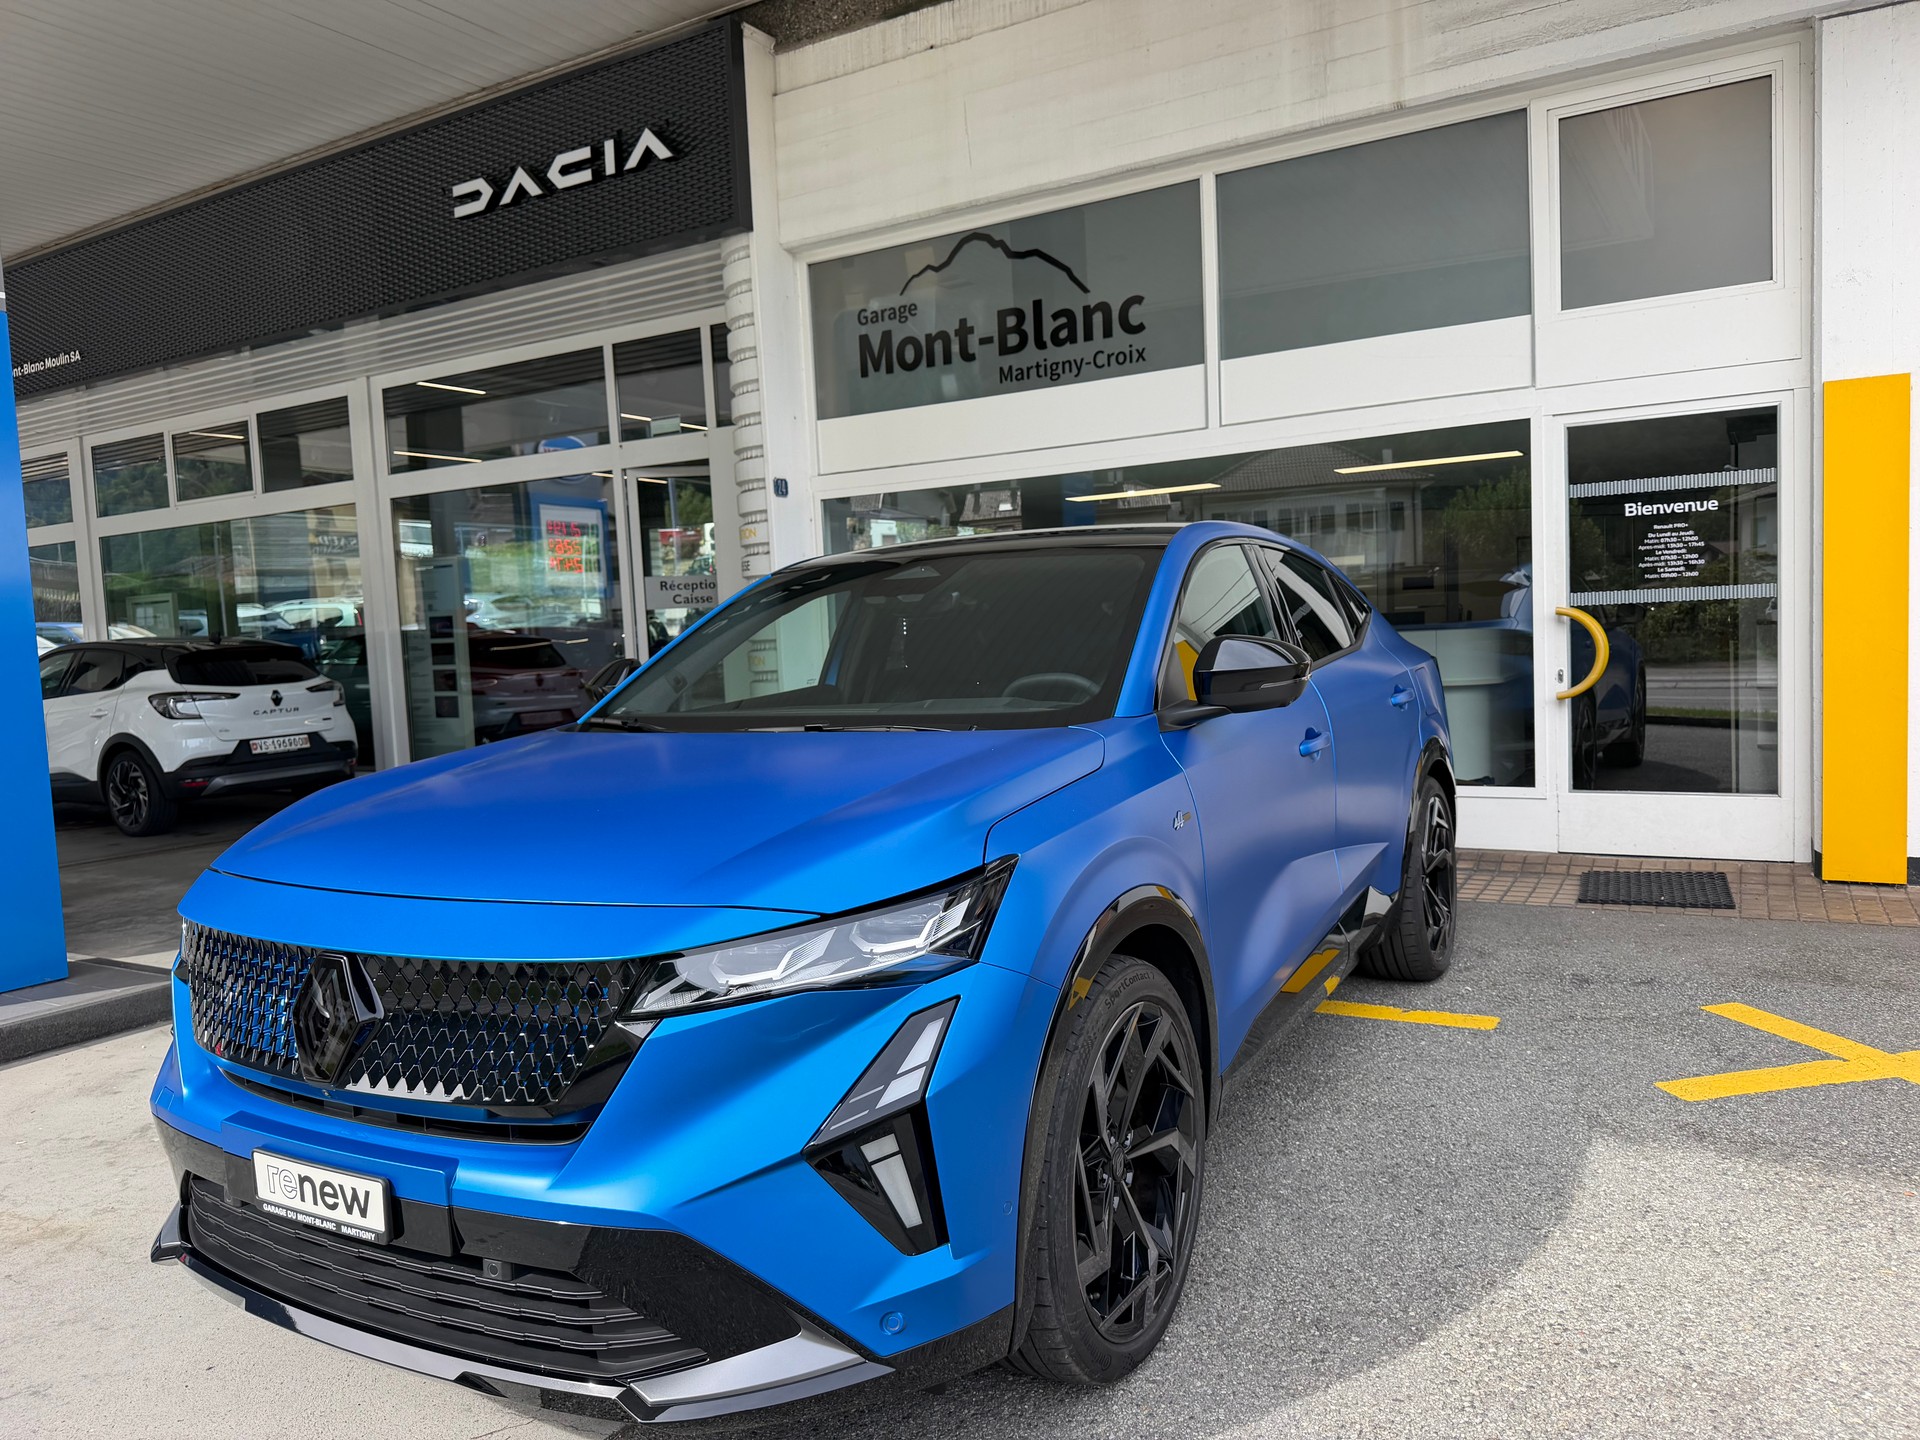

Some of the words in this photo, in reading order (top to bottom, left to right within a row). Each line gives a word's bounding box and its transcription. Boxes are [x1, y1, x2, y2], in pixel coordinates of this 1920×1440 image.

[452, 127, 674, 218] DACIA
[857, 303, 918, 326] Garage
[858, 295, 1146, 378] Mont-Blanc
[12, 361, 45, 378] nt-Blanc
[45, 352, 70, 369] Moulin
[70, 350, 81, 363] SA
[999, 344, 1147, 384] Martigny-Croix
[1624, 500, 1719, 517] Bienvenue
[660, 580, 716, 593] Réceptio
[672, 594, 713, 605] Caisse
[253, 707, 300, 716] CAPTUR
[267, 1165, 370, 1219] renew
[262, 1203, 287, 1217] GARAGE
[287, 1210, 297, 1219] DU
[297, 1213, 337, 1231] MONT-BLANC
[341, 1225, 376, 1241] MARTIGNY
